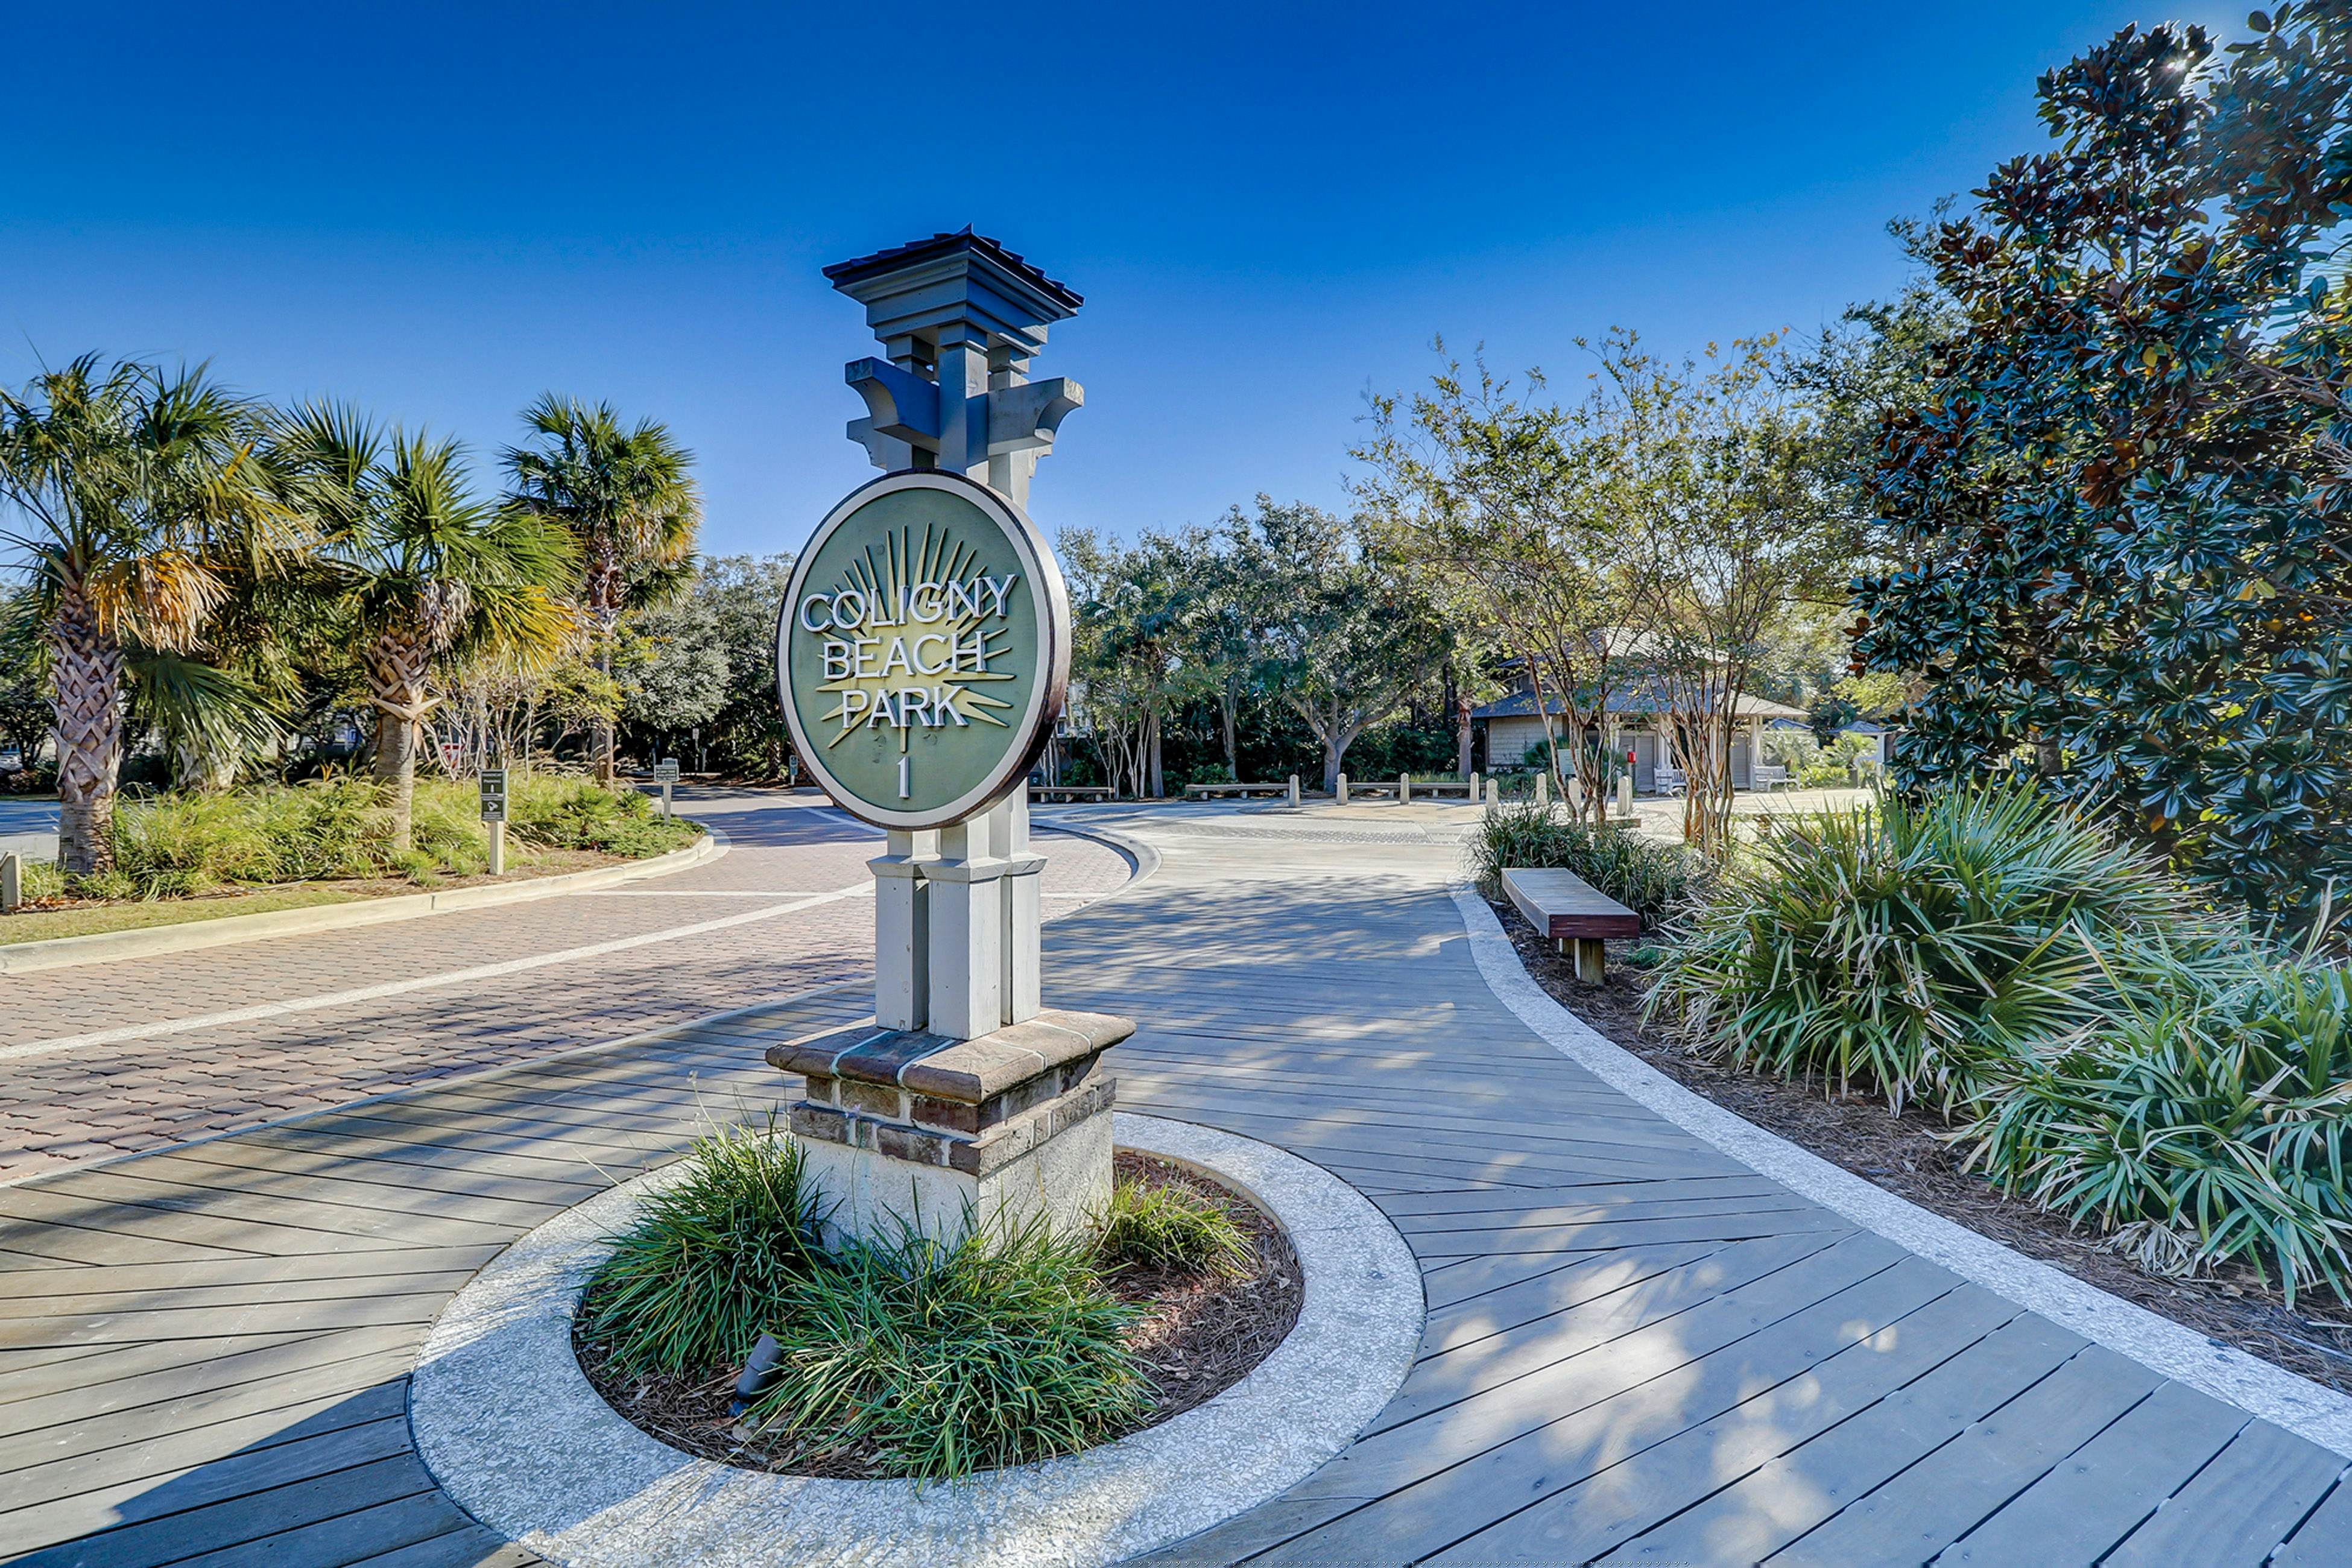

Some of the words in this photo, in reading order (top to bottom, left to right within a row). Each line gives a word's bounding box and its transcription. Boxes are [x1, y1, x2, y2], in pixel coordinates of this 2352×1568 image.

[800, 574, 1019, 633] COLIGNY
[823, 631, 988, 680] BEACH
[842, 685, 969, 729] PARK
[897, 756, 910, 798] 1
